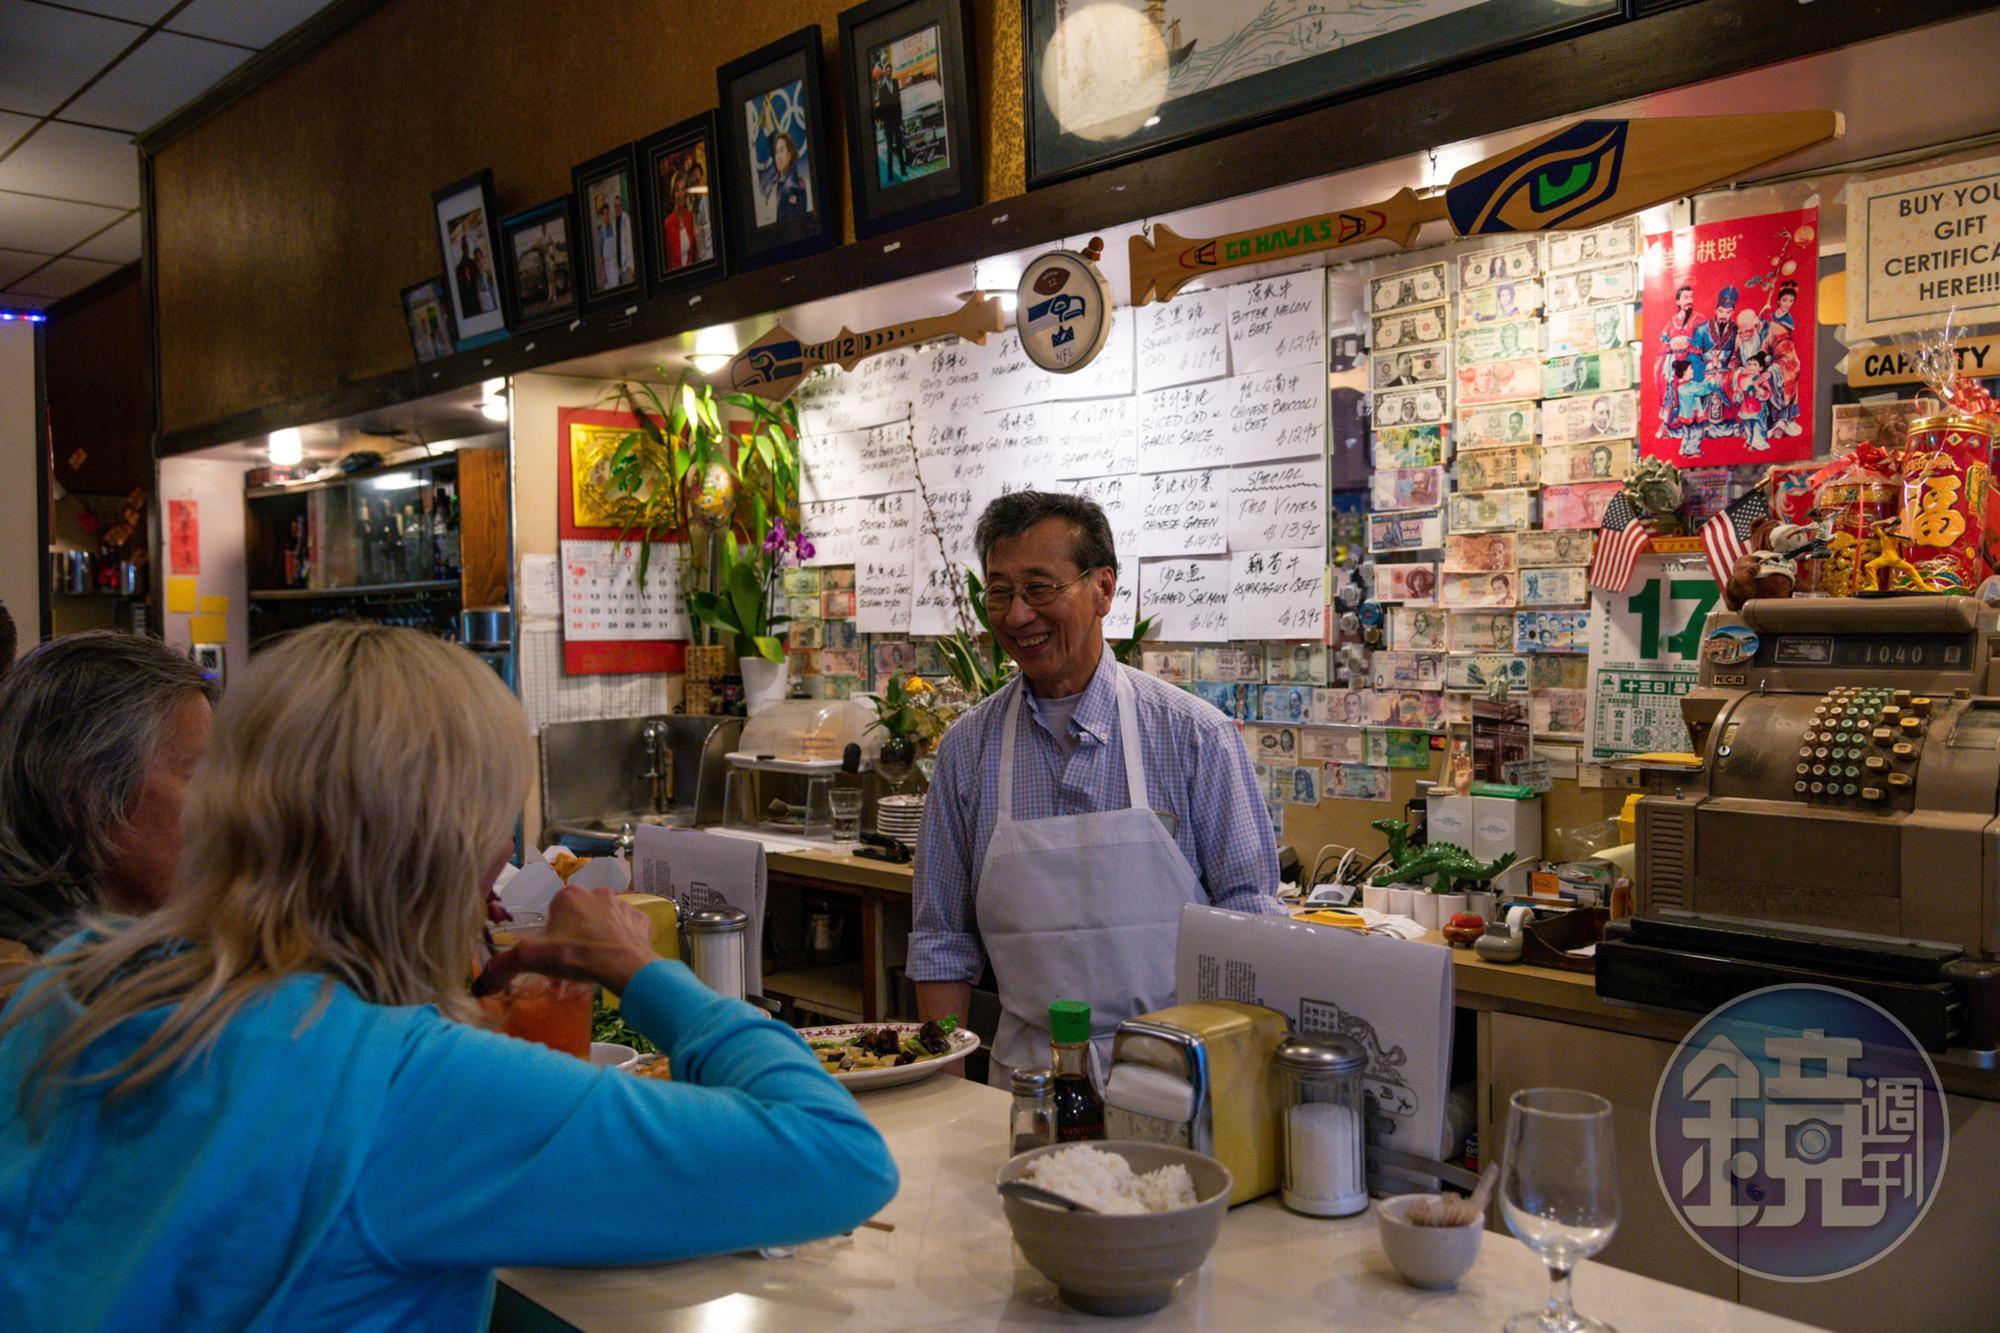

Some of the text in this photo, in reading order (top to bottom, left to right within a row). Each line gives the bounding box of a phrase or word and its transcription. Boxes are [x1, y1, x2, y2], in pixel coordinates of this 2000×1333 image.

[1899, 193, 1945, 217] BUY
[1934, 215, 1987, 240] GIFT
[1225, 219, 1332, 260] GO HAWKS
[1919, 272, 2000, 302] HERE!!!
[1274, 300, 1312, 319] MELON
[1248, 322, 1273, 339] BEEF
[836, 338, 855, 358] 12
[1055, 347, 1075, 362] NFL
[1141, 412, 1182, 433] SLICED
[1184, 410, 1207, 427] COD
[1179, 428, 1215, 446] SAUCE
[1248, 468, 1303, 485] SPECIAL
[1143, 503, 1181, 518] SLICED
[1186, 500, 1205, 513] COD
[1239, 497, 1318, 520] PEA VINES
[1143, 515, 1216, 531] CHINESE GREEN
[1661, 562, 1689, 572] MAY
[1142, 587, 1228, 608] STEAMED SALMON
[1232, 576, 1322, 602] ASPARAGUS BEEF
[1628, 578, 1720, 661] 17
[1624, 680, 1666, 694] 十三日
[1715, 675, 1743, 684] NCR
